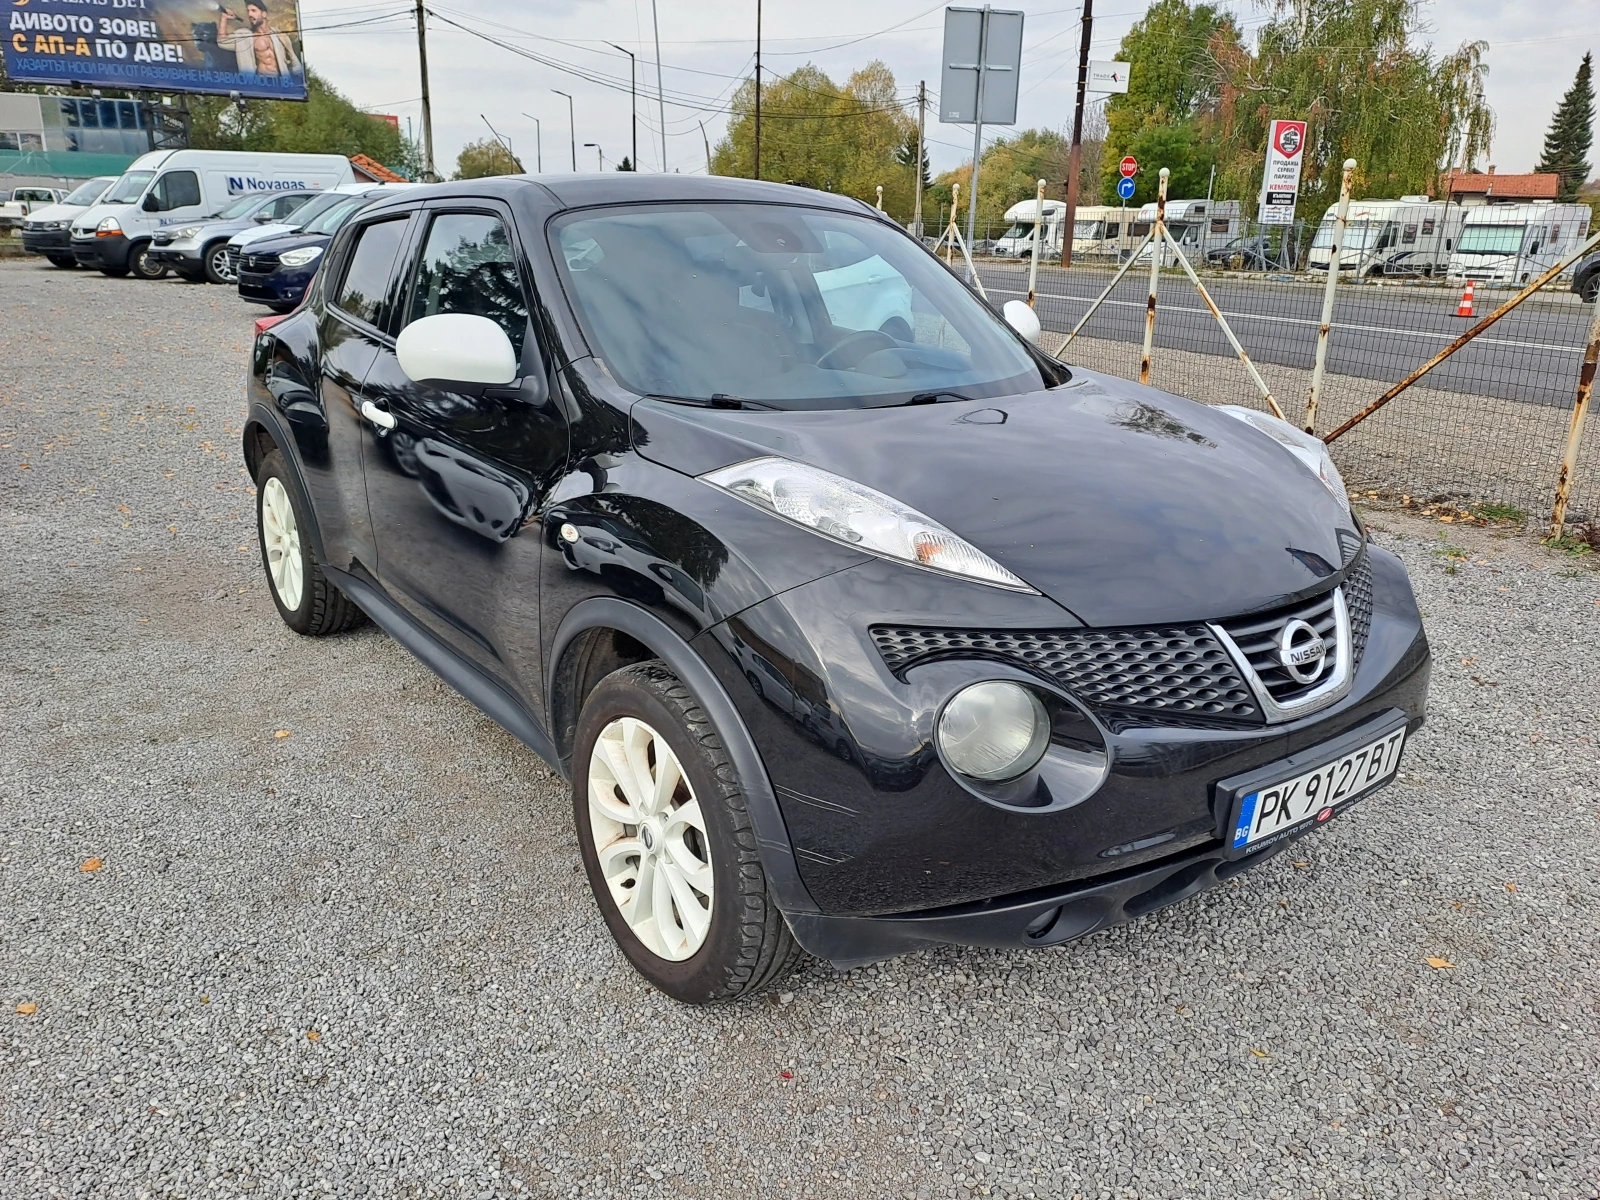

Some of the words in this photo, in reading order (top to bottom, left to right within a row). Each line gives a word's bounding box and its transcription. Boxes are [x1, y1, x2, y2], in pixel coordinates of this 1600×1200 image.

[10, 11, 94, 33] ДИВОТО
[99, 18, 158, 38] ЗОВЕ!
[12, 33, 28, 53] С
[34, 34, 91, 56] АП-А
[95, 38, 128, 59] ПО
[134, 42, 184, 63] ДВЕ!
[16, 58, 66, 72] ХАЗАРТЪТ
[68, 61, 97, 75] НОСИ
[98, 62, 125, 76] РИСК
[126, 64, 139, 77] ОТ
[141, 66, 197, 82] РАЗВИВАНЕ
[199, 70, 213, 83] НА
[1121, 163, 1136, 171] STOP
[246, 177, 306, 190] Novagas
[1290, 643, 1325, 663] NISSAN
[1234, 825, 1249, 841] BG
[1245, 835, 1279, 854] KRUMOV
[1279, 826, 1299, 841] AUTO
